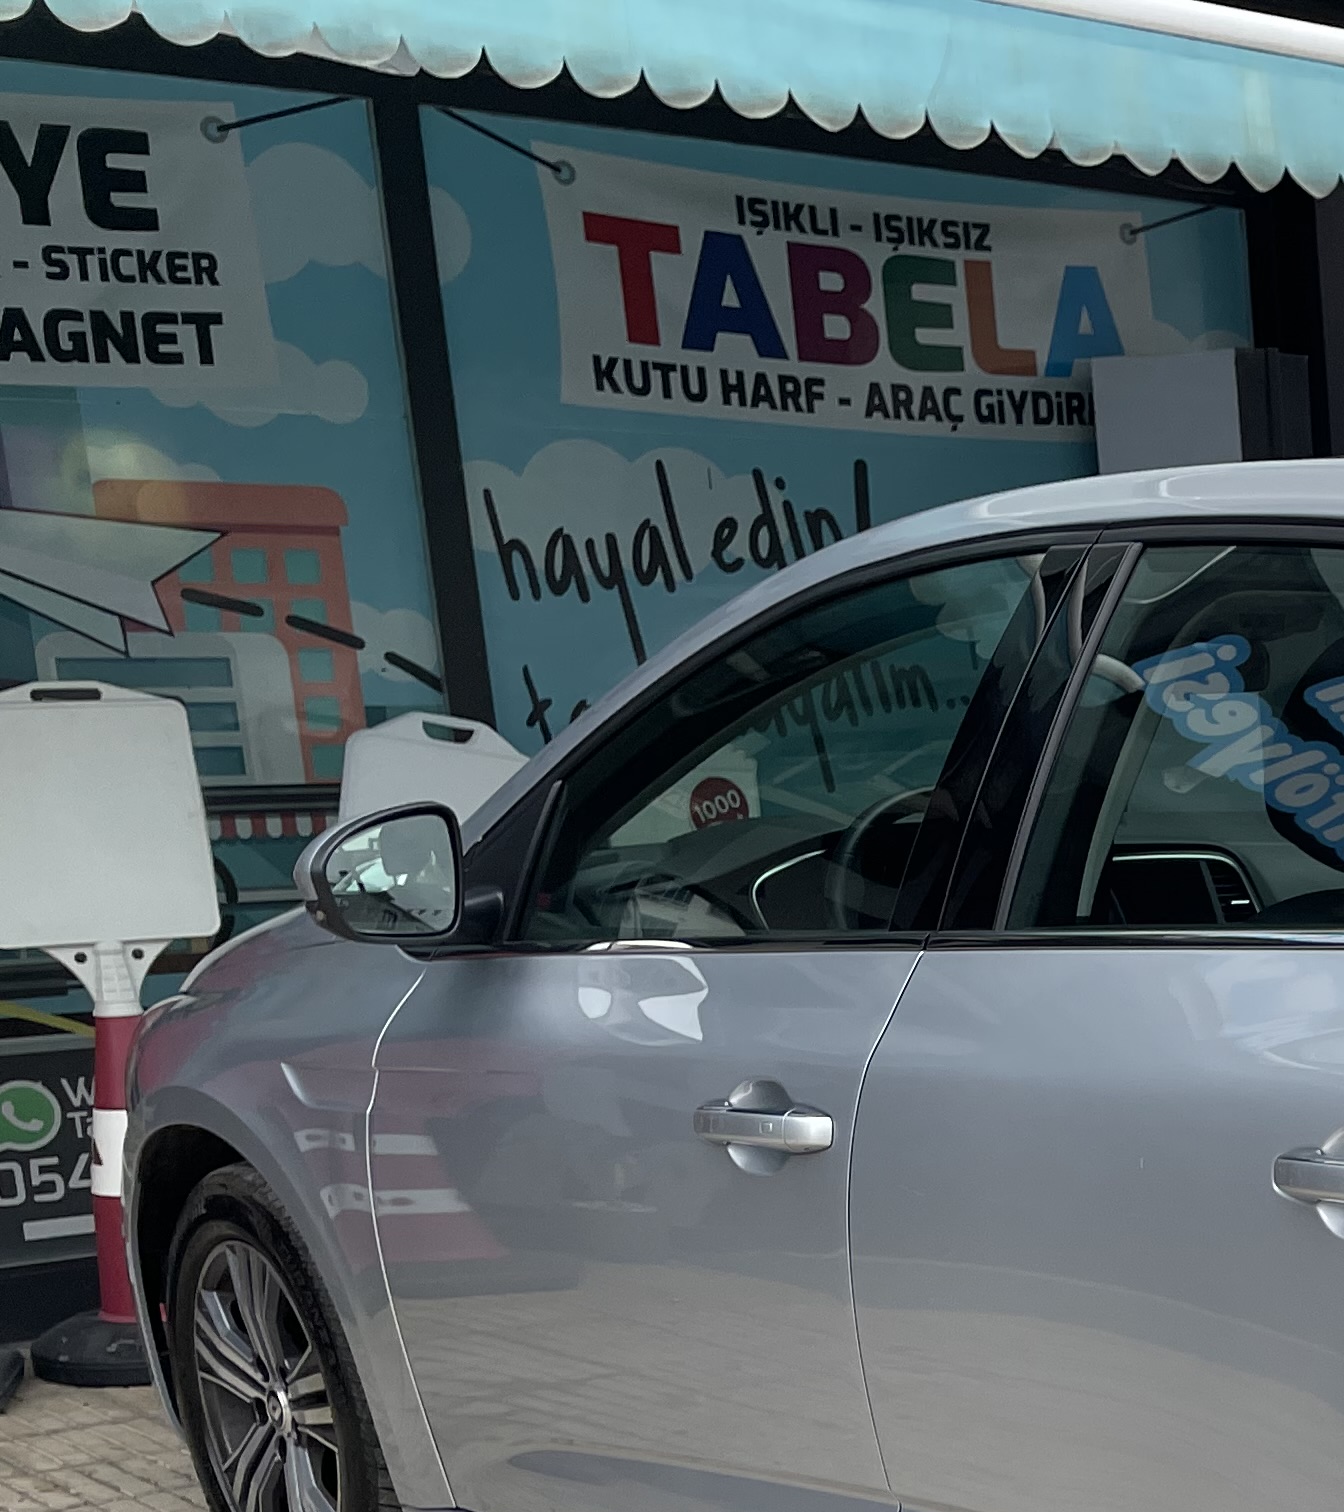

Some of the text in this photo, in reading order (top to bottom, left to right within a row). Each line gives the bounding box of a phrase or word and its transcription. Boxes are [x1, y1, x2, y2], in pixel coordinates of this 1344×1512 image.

[735, 194, 840, 238] IŞIKLI
[873, 214, 993, 253] IŞIKSIZ
[582, 210, 1127, 380] TABELA
[0, 307, 224, 367] AGNET
[592, 354, 708, 404] KUTU
[720, 368, 826, 415] HARF
[864, 382, 965, 433] ARAÇ
[484, 459, 694, 665] hayal
[694, 789, 741, 823] 1000
